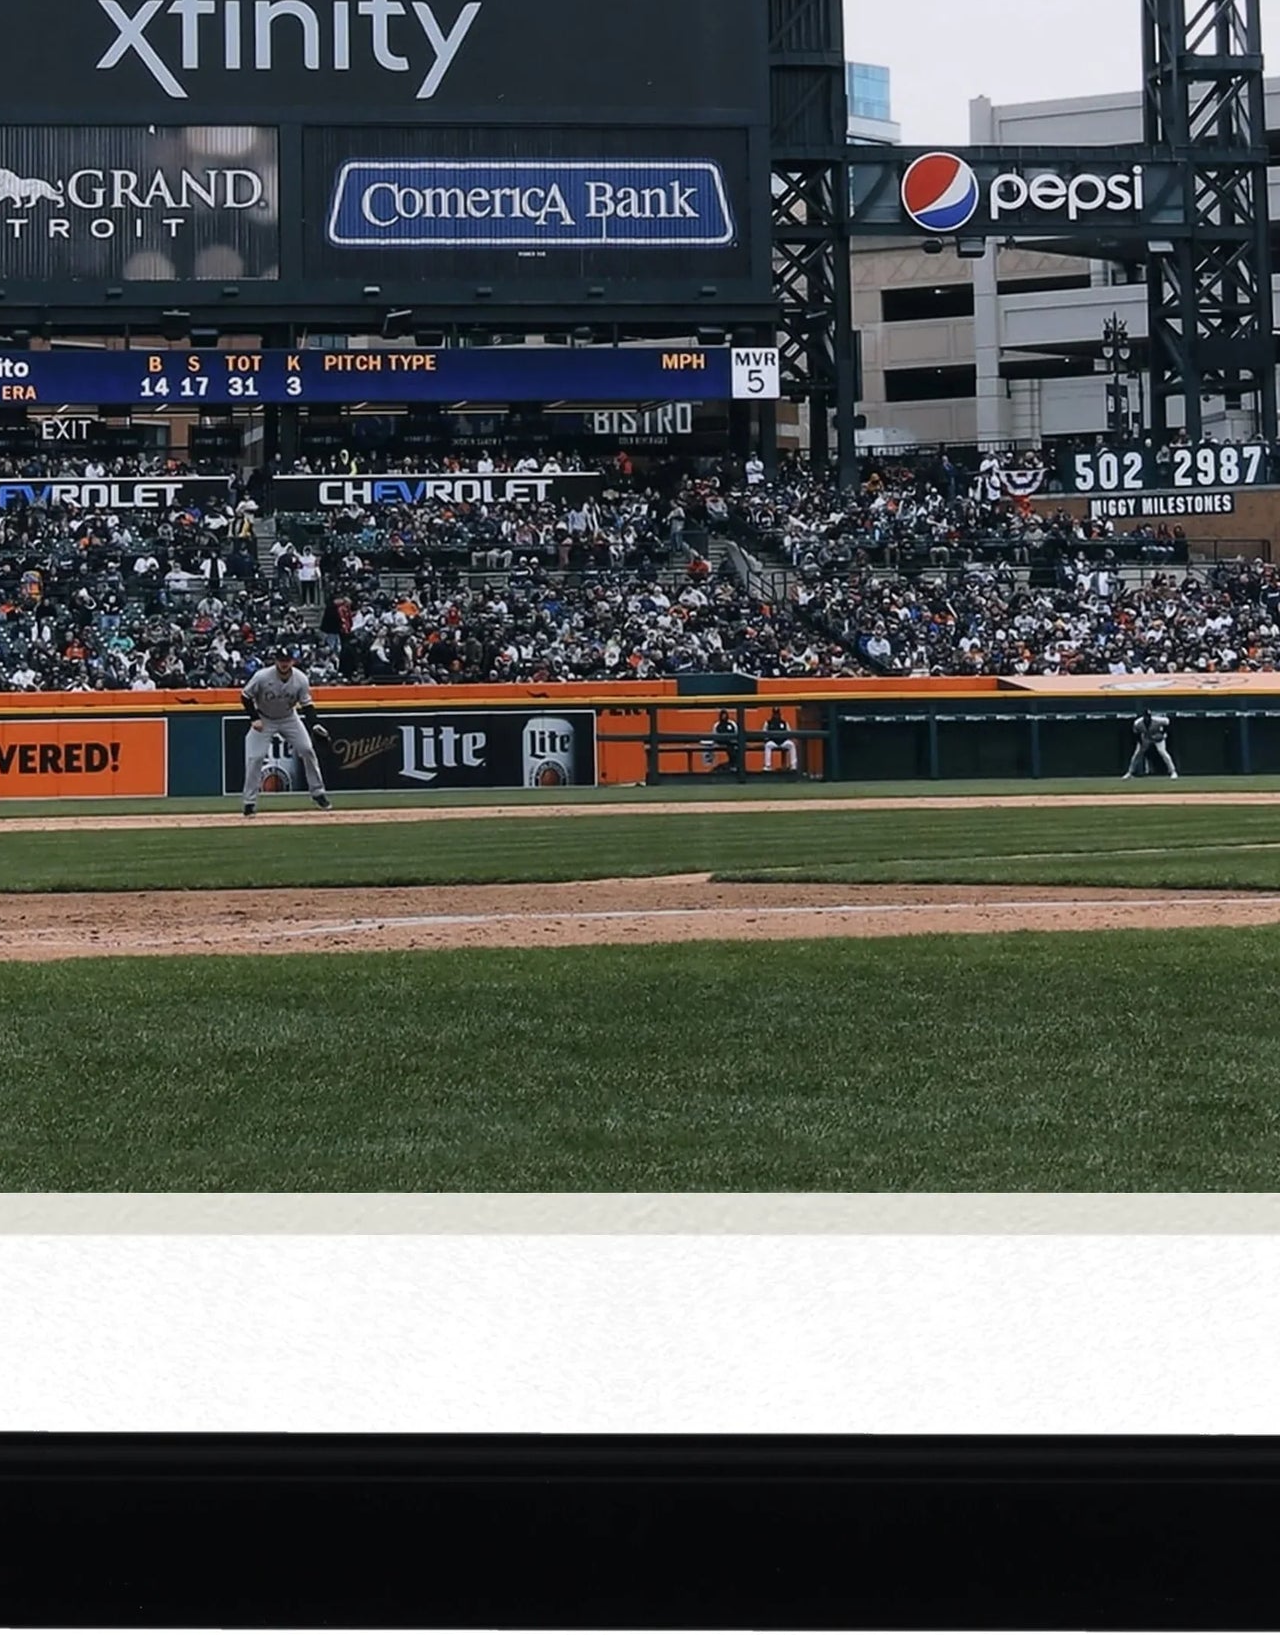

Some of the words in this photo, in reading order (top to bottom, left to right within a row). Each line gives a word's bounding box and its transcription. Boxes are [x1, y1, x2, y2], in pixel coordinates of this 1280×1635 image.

[586, 180, 700, 220] Bank
[990, 165, 1143, 220] pepsi
[225, 356, 261, 372] TOT
[325, 354, 381, 371] PITCH
[388, 354, 436, 371] TYPE
[662, 354, 704, 369] MPH
[736, 351, 776, 366] MVR
[1, 386, 37, 400] ERA
[141, 378, 169, 396] 14
[180, 377, 209, 396] 17
[228, 377, 259, 396] 31
[42, 421, 91, 441] EXIT
[1074, 451, 1143, 491] 502
[1174, 445, 1261, 486] 2987
[320, 480, 553, 505] CHEVROLET
[1141, 494, 1232, 515] MILESTONES
[333, 732, 398, 768] Miller
[399, 725, 486, 781] Lite
[529, 729, 570, 758] Lite
